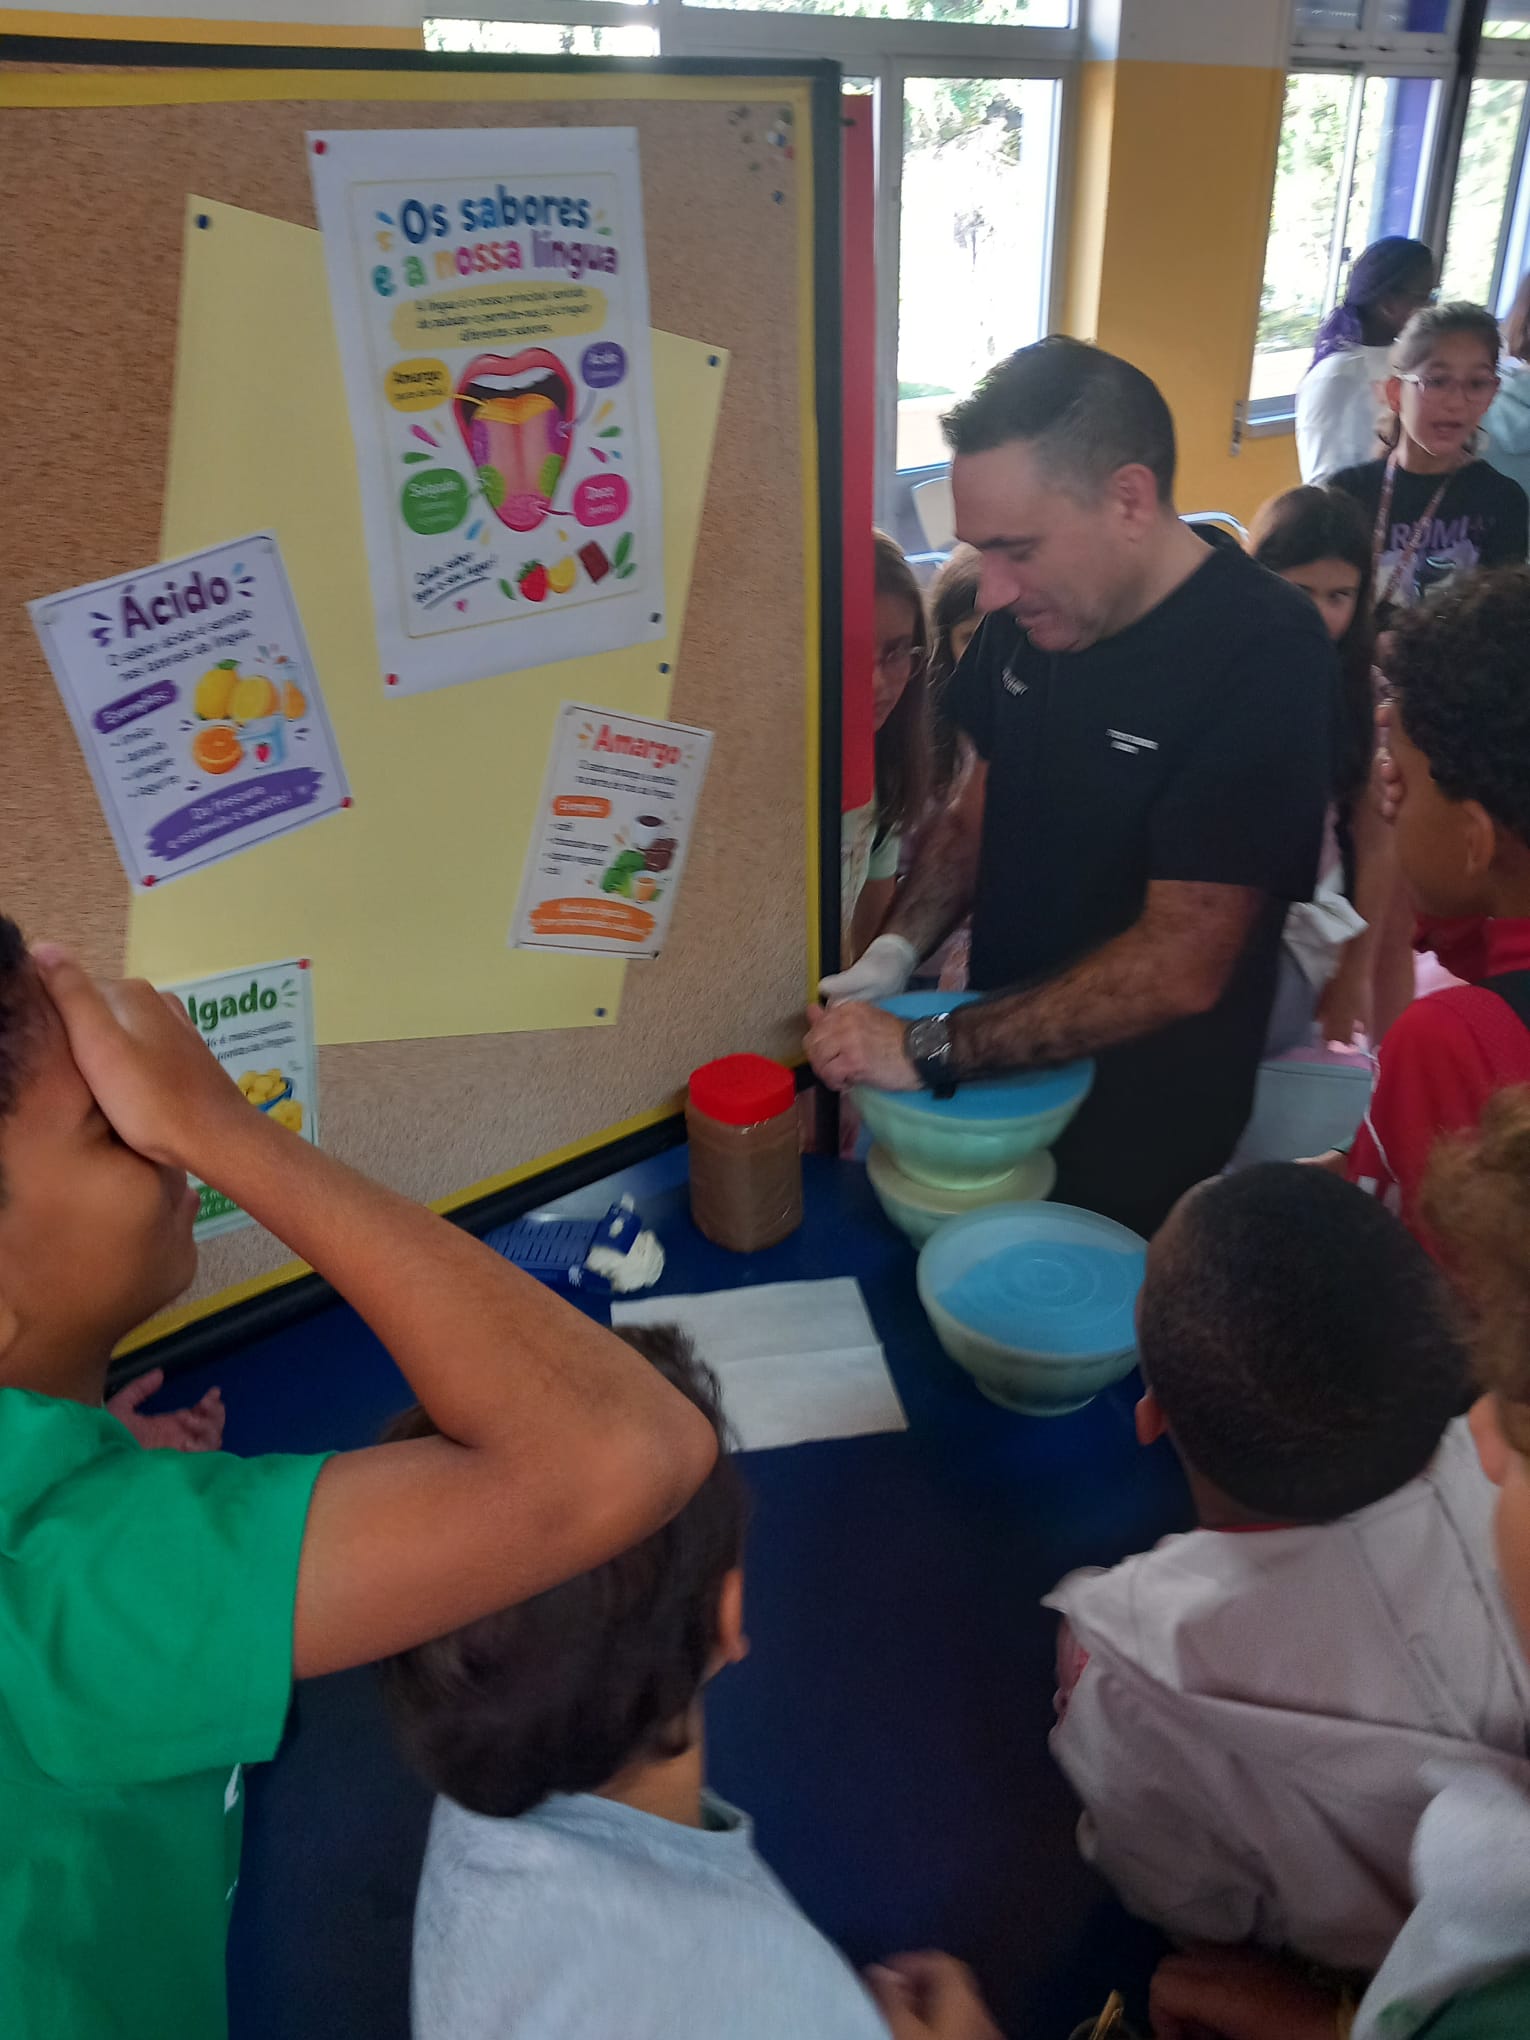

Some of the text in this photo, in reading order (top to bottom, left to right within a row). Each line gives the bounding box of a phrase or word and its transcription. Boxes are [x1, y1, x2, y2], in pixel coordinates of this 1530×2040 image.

[400, 183, 591, 244] Os sabores
[372, 264, 397, 297] e
[403, 255, 428, 287] a
[434, 240, 523, 279] nossa
[119, 571, 231, 639] Ácido
[593, 724, 682, 768] Amargo
[187, 980, 279, 1032] lgado
